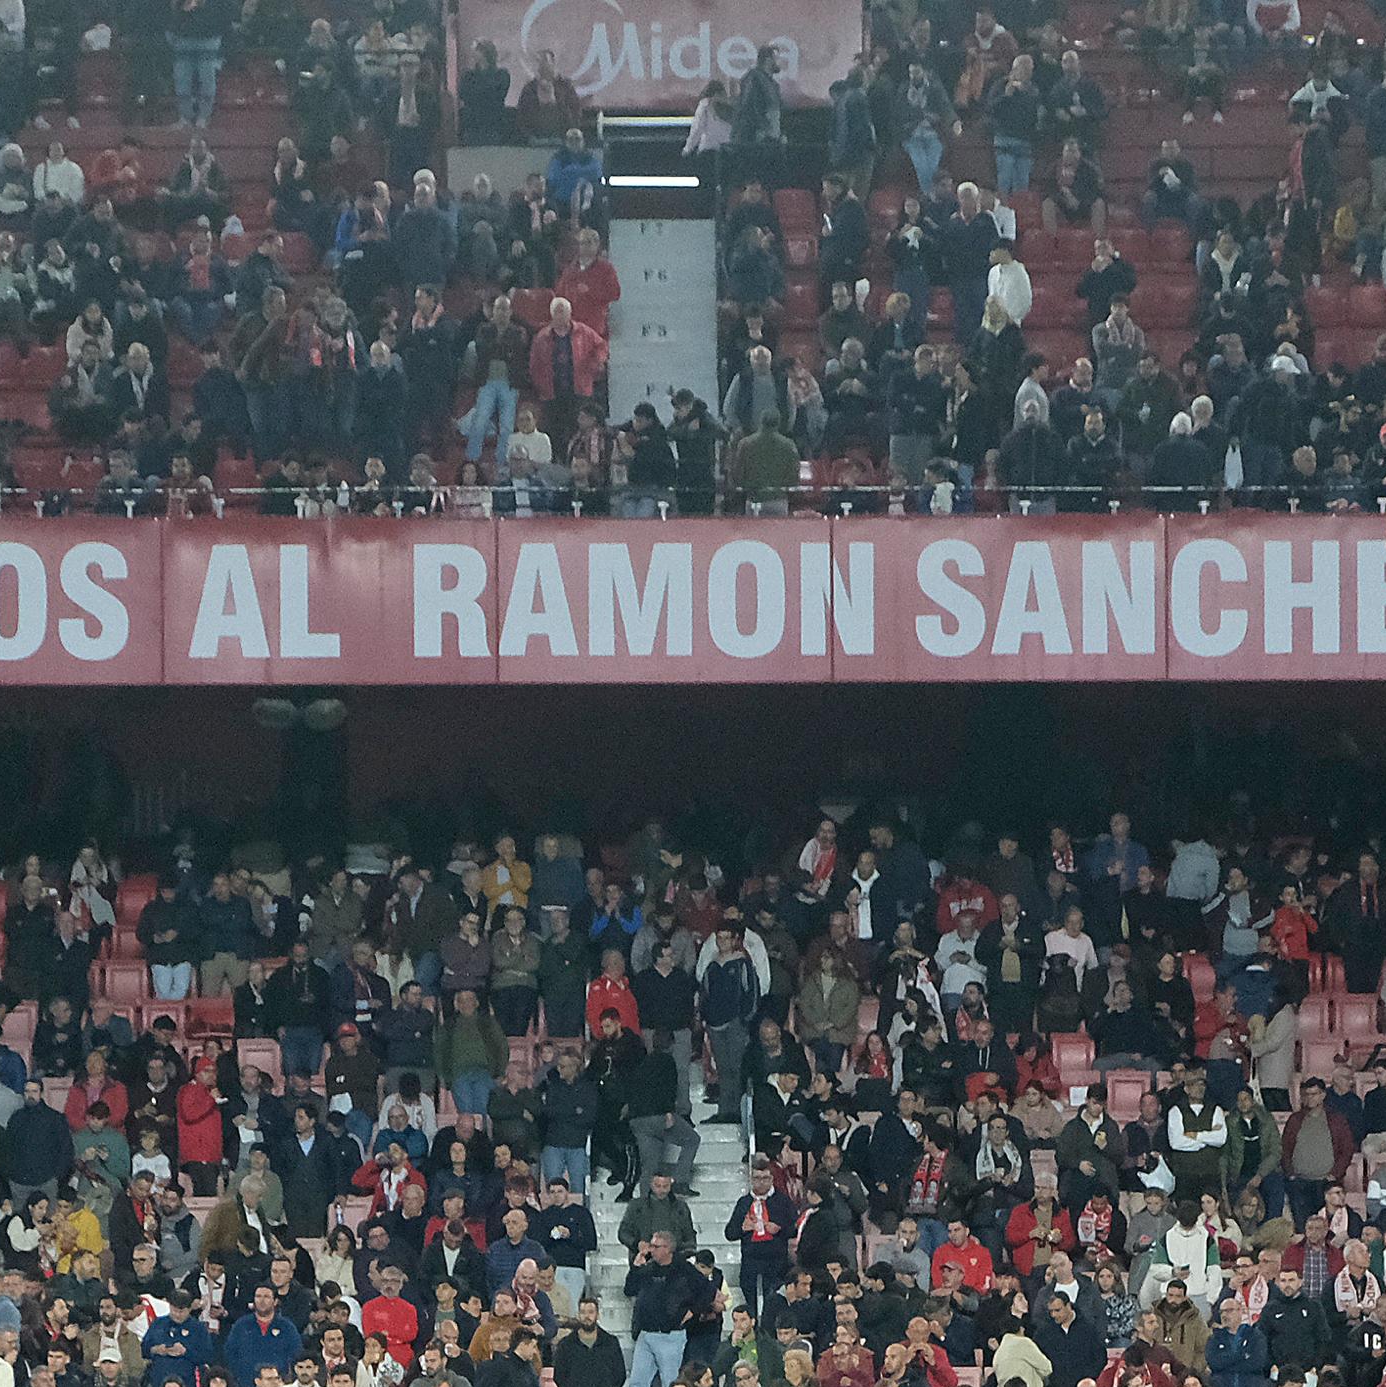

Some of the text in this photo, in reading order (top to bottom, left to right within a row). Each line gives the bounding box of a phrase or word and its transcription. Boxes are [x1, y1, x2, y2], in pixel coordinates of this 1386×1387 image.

[571, 22, 798, 81] Midea
[188, 543, 341, 658] AL
[413, 539, 875, 658] RAMON
